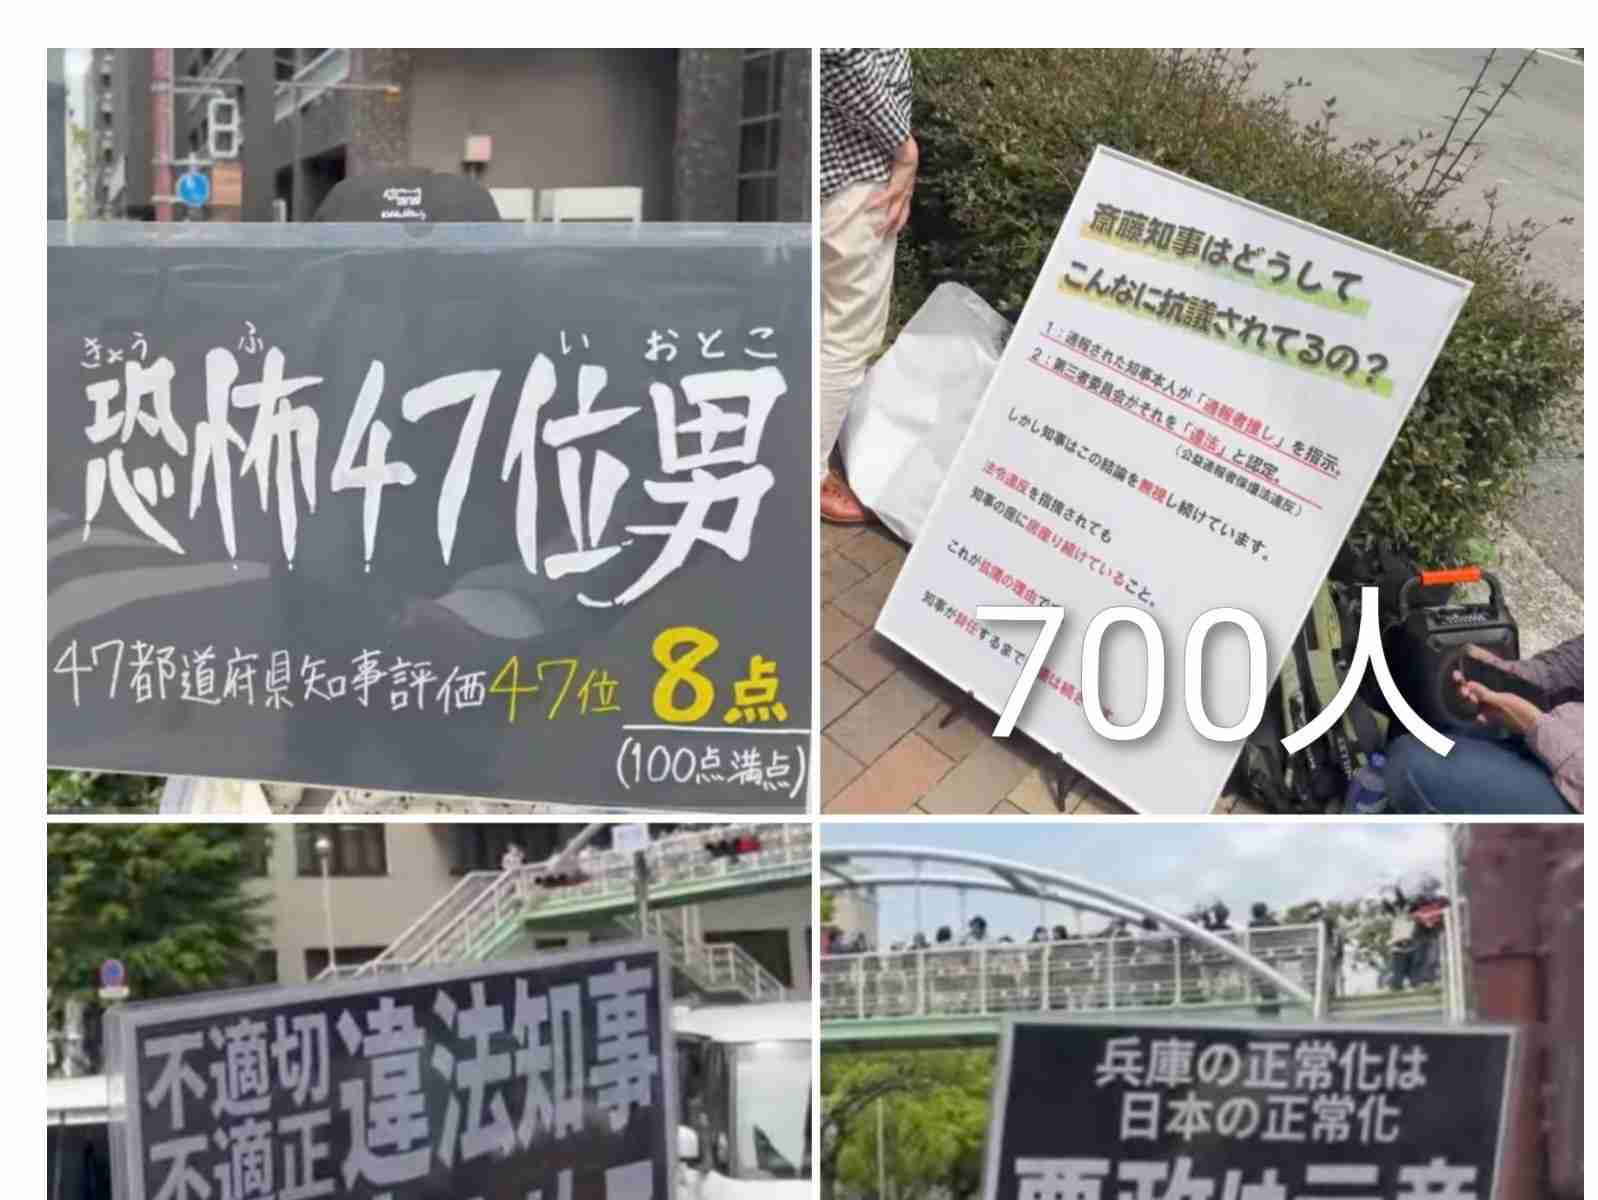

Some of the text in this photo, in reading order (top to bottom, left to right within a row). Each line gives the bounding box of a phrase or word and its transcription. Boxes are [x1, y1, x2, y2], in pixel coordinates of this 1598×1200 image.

[561, 331, 589, 356] い
[644, 326, 780, 361] おとこ
[81, 346, 788, 607] 恐怖47位男
[652, 625, 788, 724] 8点
[616, 736, 807, 795] (100点満点)
[144, 1008, 330, 1130] 不適切
[336, 960, 660, 1189] 違法知事
[1096, 1036, 1427, 1089] 兵庫の正常化は
[1120, 1093, 1401, 1144] 日本の正常化
